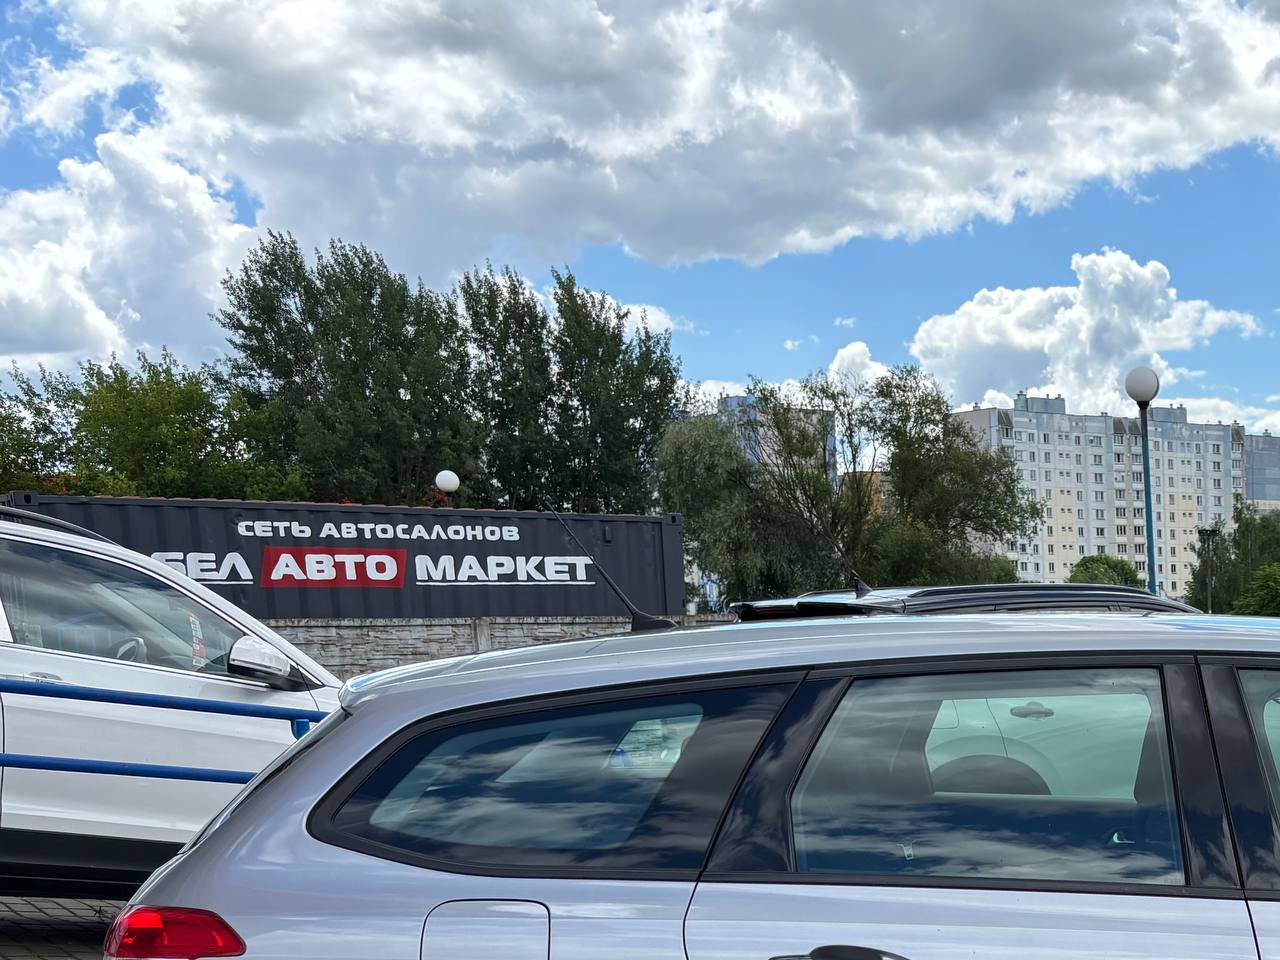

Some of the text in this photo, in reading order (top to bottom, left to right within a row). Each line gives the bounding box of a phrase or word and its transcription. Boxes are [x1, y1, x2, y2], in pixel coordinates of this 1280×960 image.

[237, 520, 520, 541] СЕТЬ АВТОСАЛОНОВ
[270, 553, 398, 580] АВТО
[414, 554, 594, 581] МАРКЕТ
